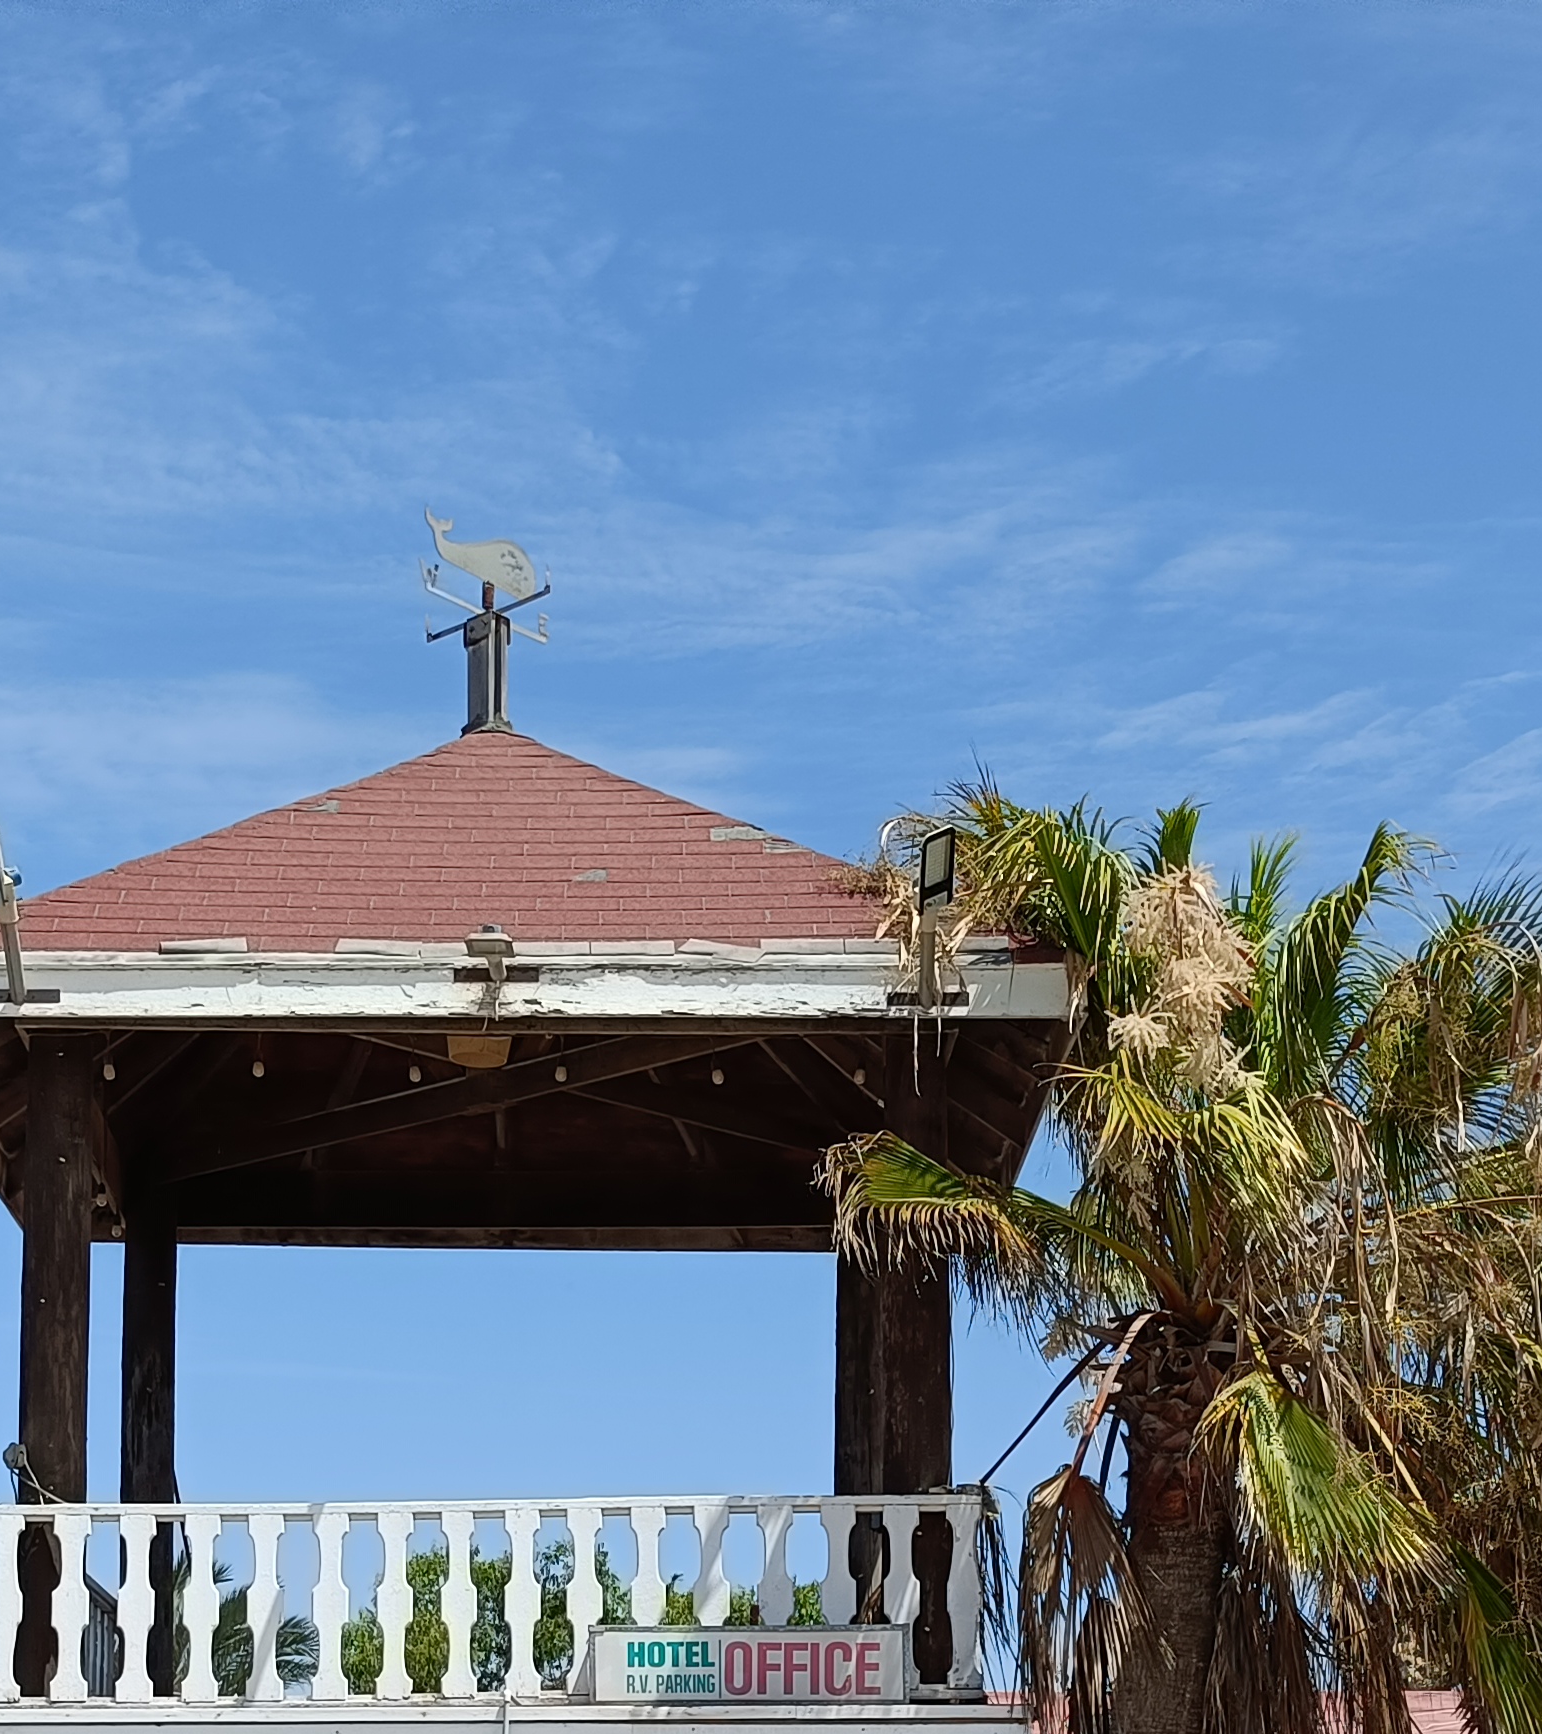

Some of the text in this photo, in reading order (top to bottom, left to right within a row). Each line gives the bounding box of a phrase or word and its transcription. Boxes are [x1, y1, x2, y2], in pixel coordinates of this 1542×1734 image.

[626, 1641, 881, 1696] HOTEL OFFICE
[626, 1674, 716, 1694] R.V. PARKING
